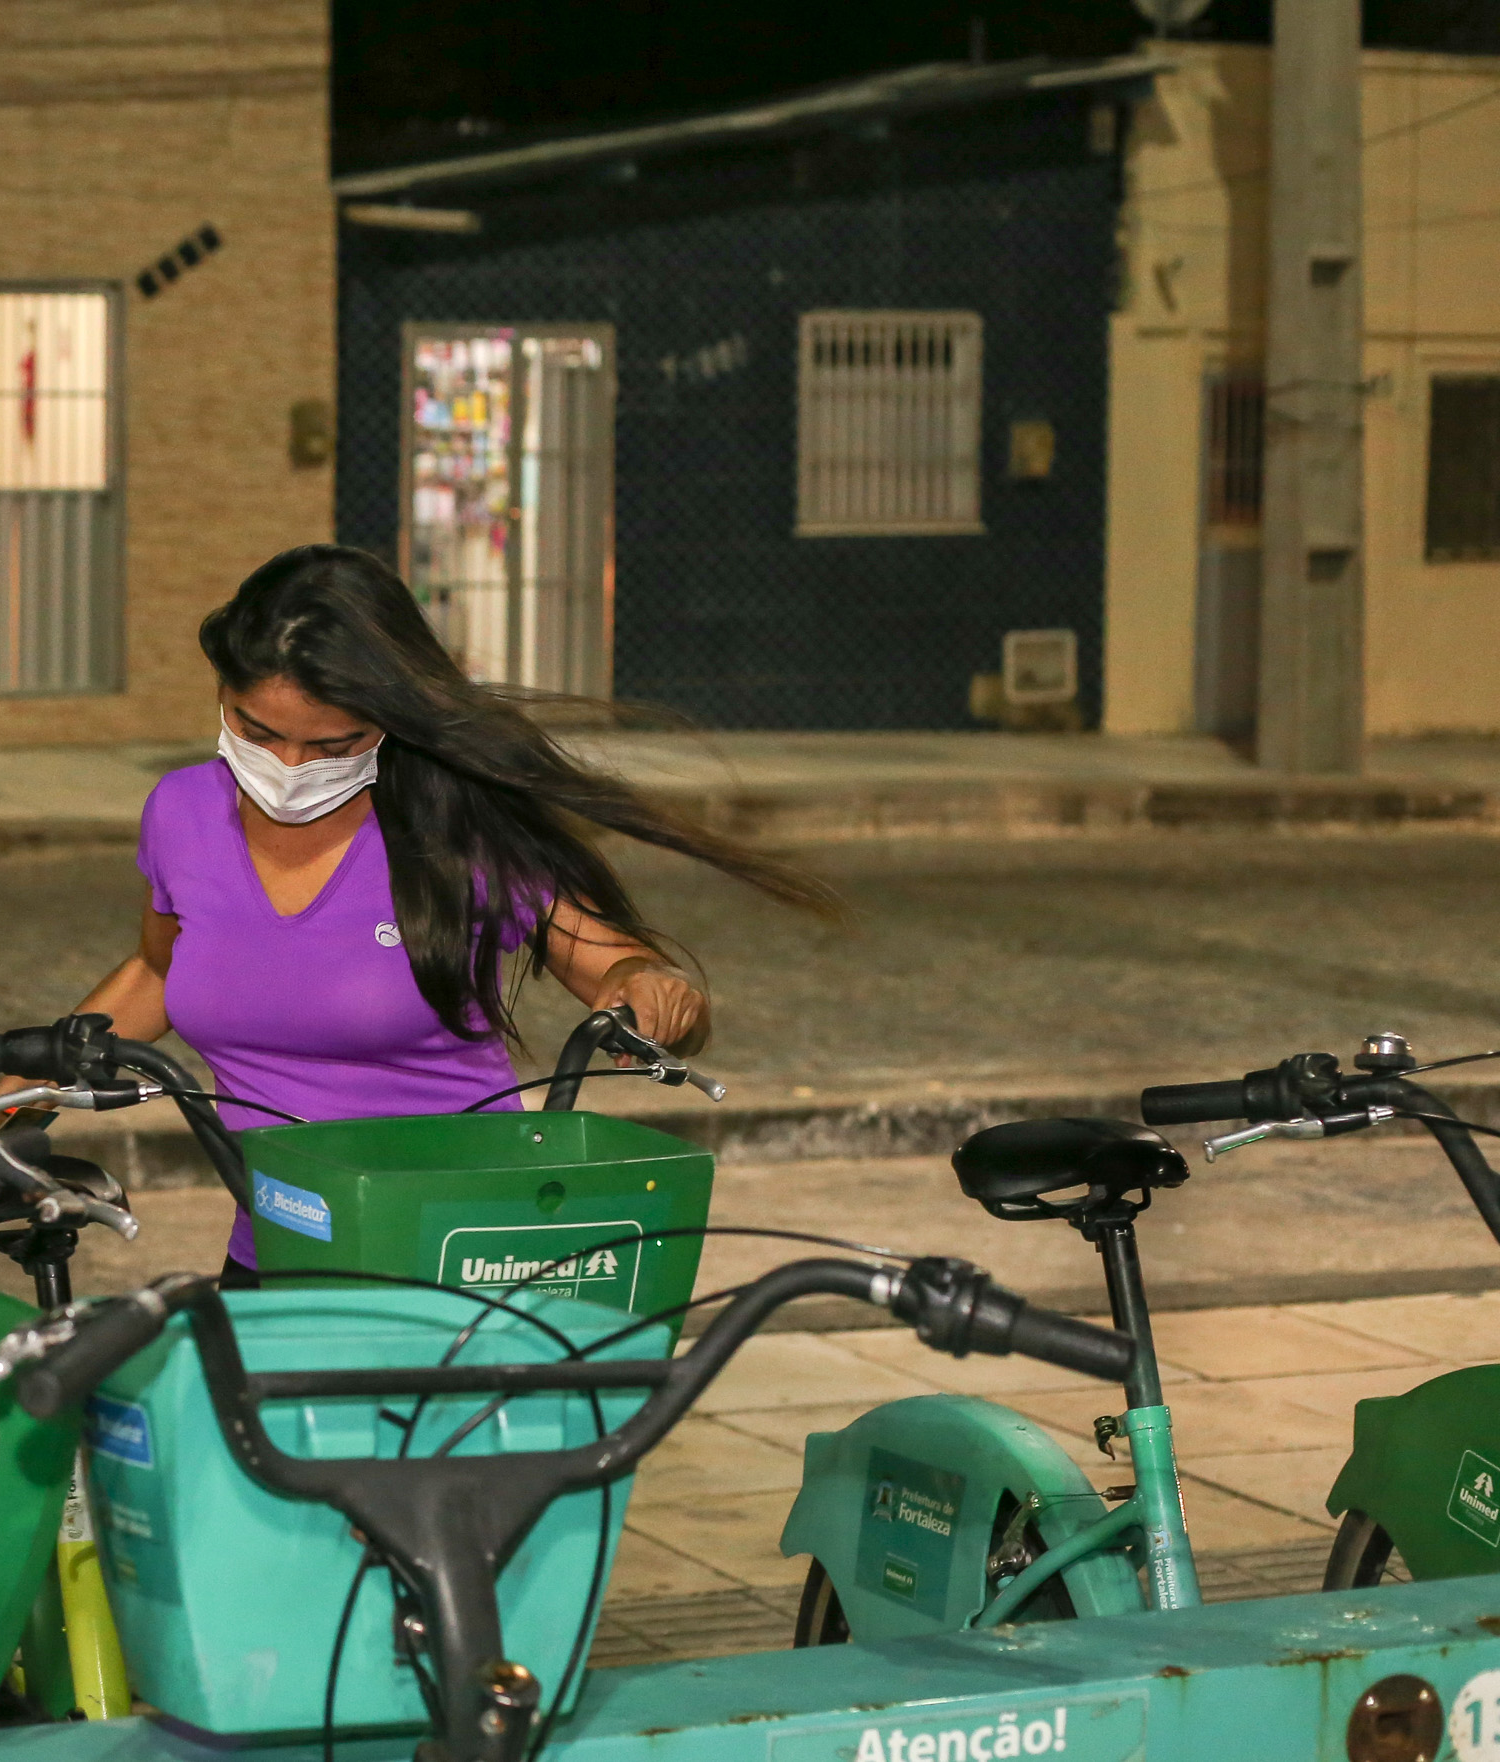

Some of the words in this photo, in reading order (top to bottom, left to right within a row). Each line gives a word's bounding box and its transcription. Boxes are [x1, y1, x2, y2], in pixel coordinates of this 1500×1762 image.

[273, 1191, 327, 1223] Bicicletar
[461, 1252, 578, 1283] Unimed
[901, 1487, 942, 1512] Prefeitura
[942, 1502, 955, 1516] de
[1459, 1487, 1499, 1521] Unimed
[898, 1502, 952, 1537] Fortaleza
[1153, 1558, 1169, 1611] Fortalez
[1164, 1557, 1176, 1602] Prefeitura
[854, 1706, 1068, 1762] Atenção!
